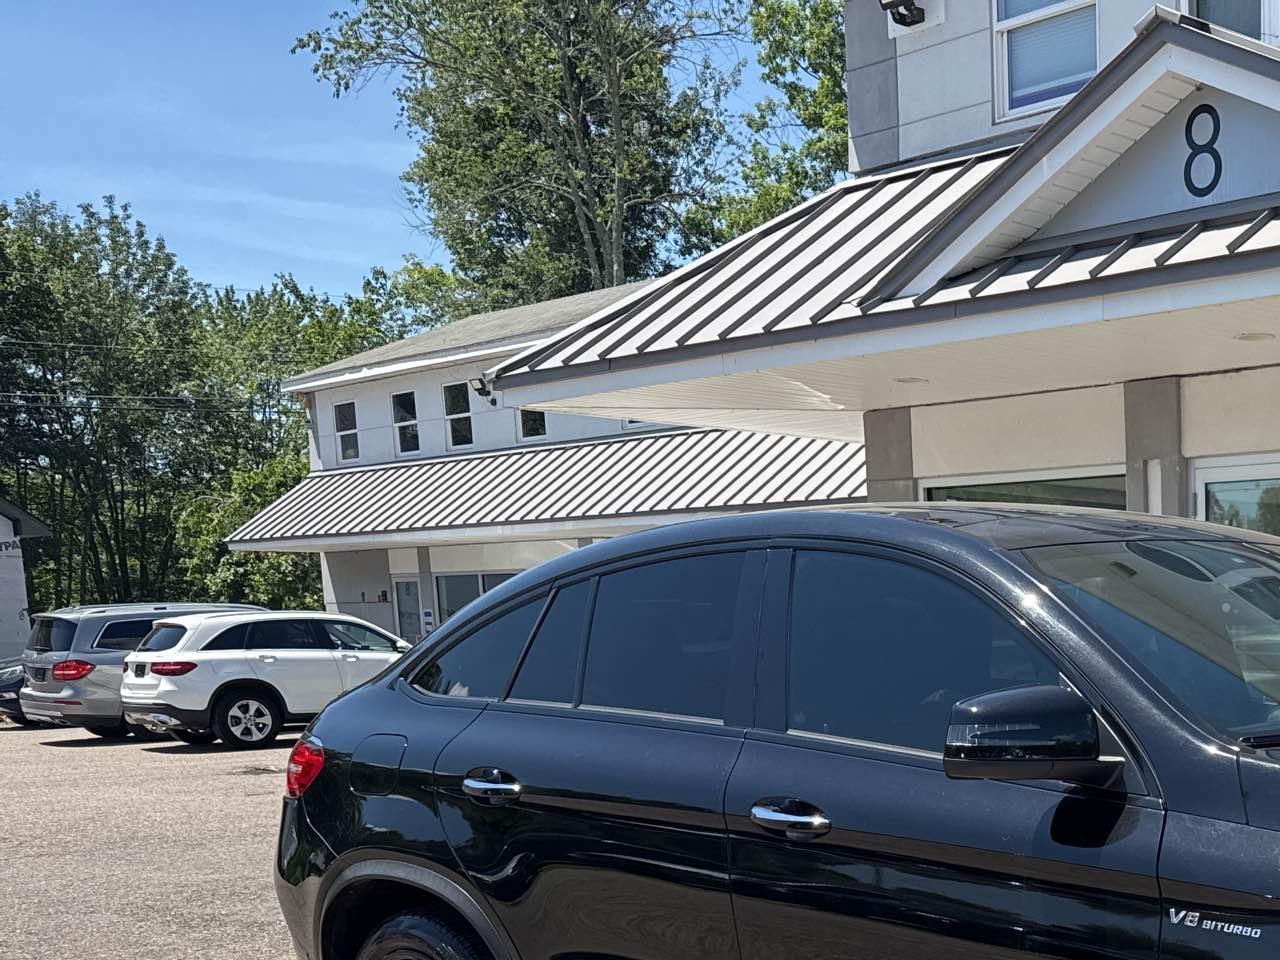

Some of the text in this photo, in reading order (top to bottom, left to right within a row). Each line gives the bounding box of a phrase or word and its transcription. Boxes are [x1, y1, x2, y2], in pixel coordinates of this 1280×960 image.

[1184, 104, 1222, 197] 8
[1169, 908, 1261, 938] V8 BITURBO
